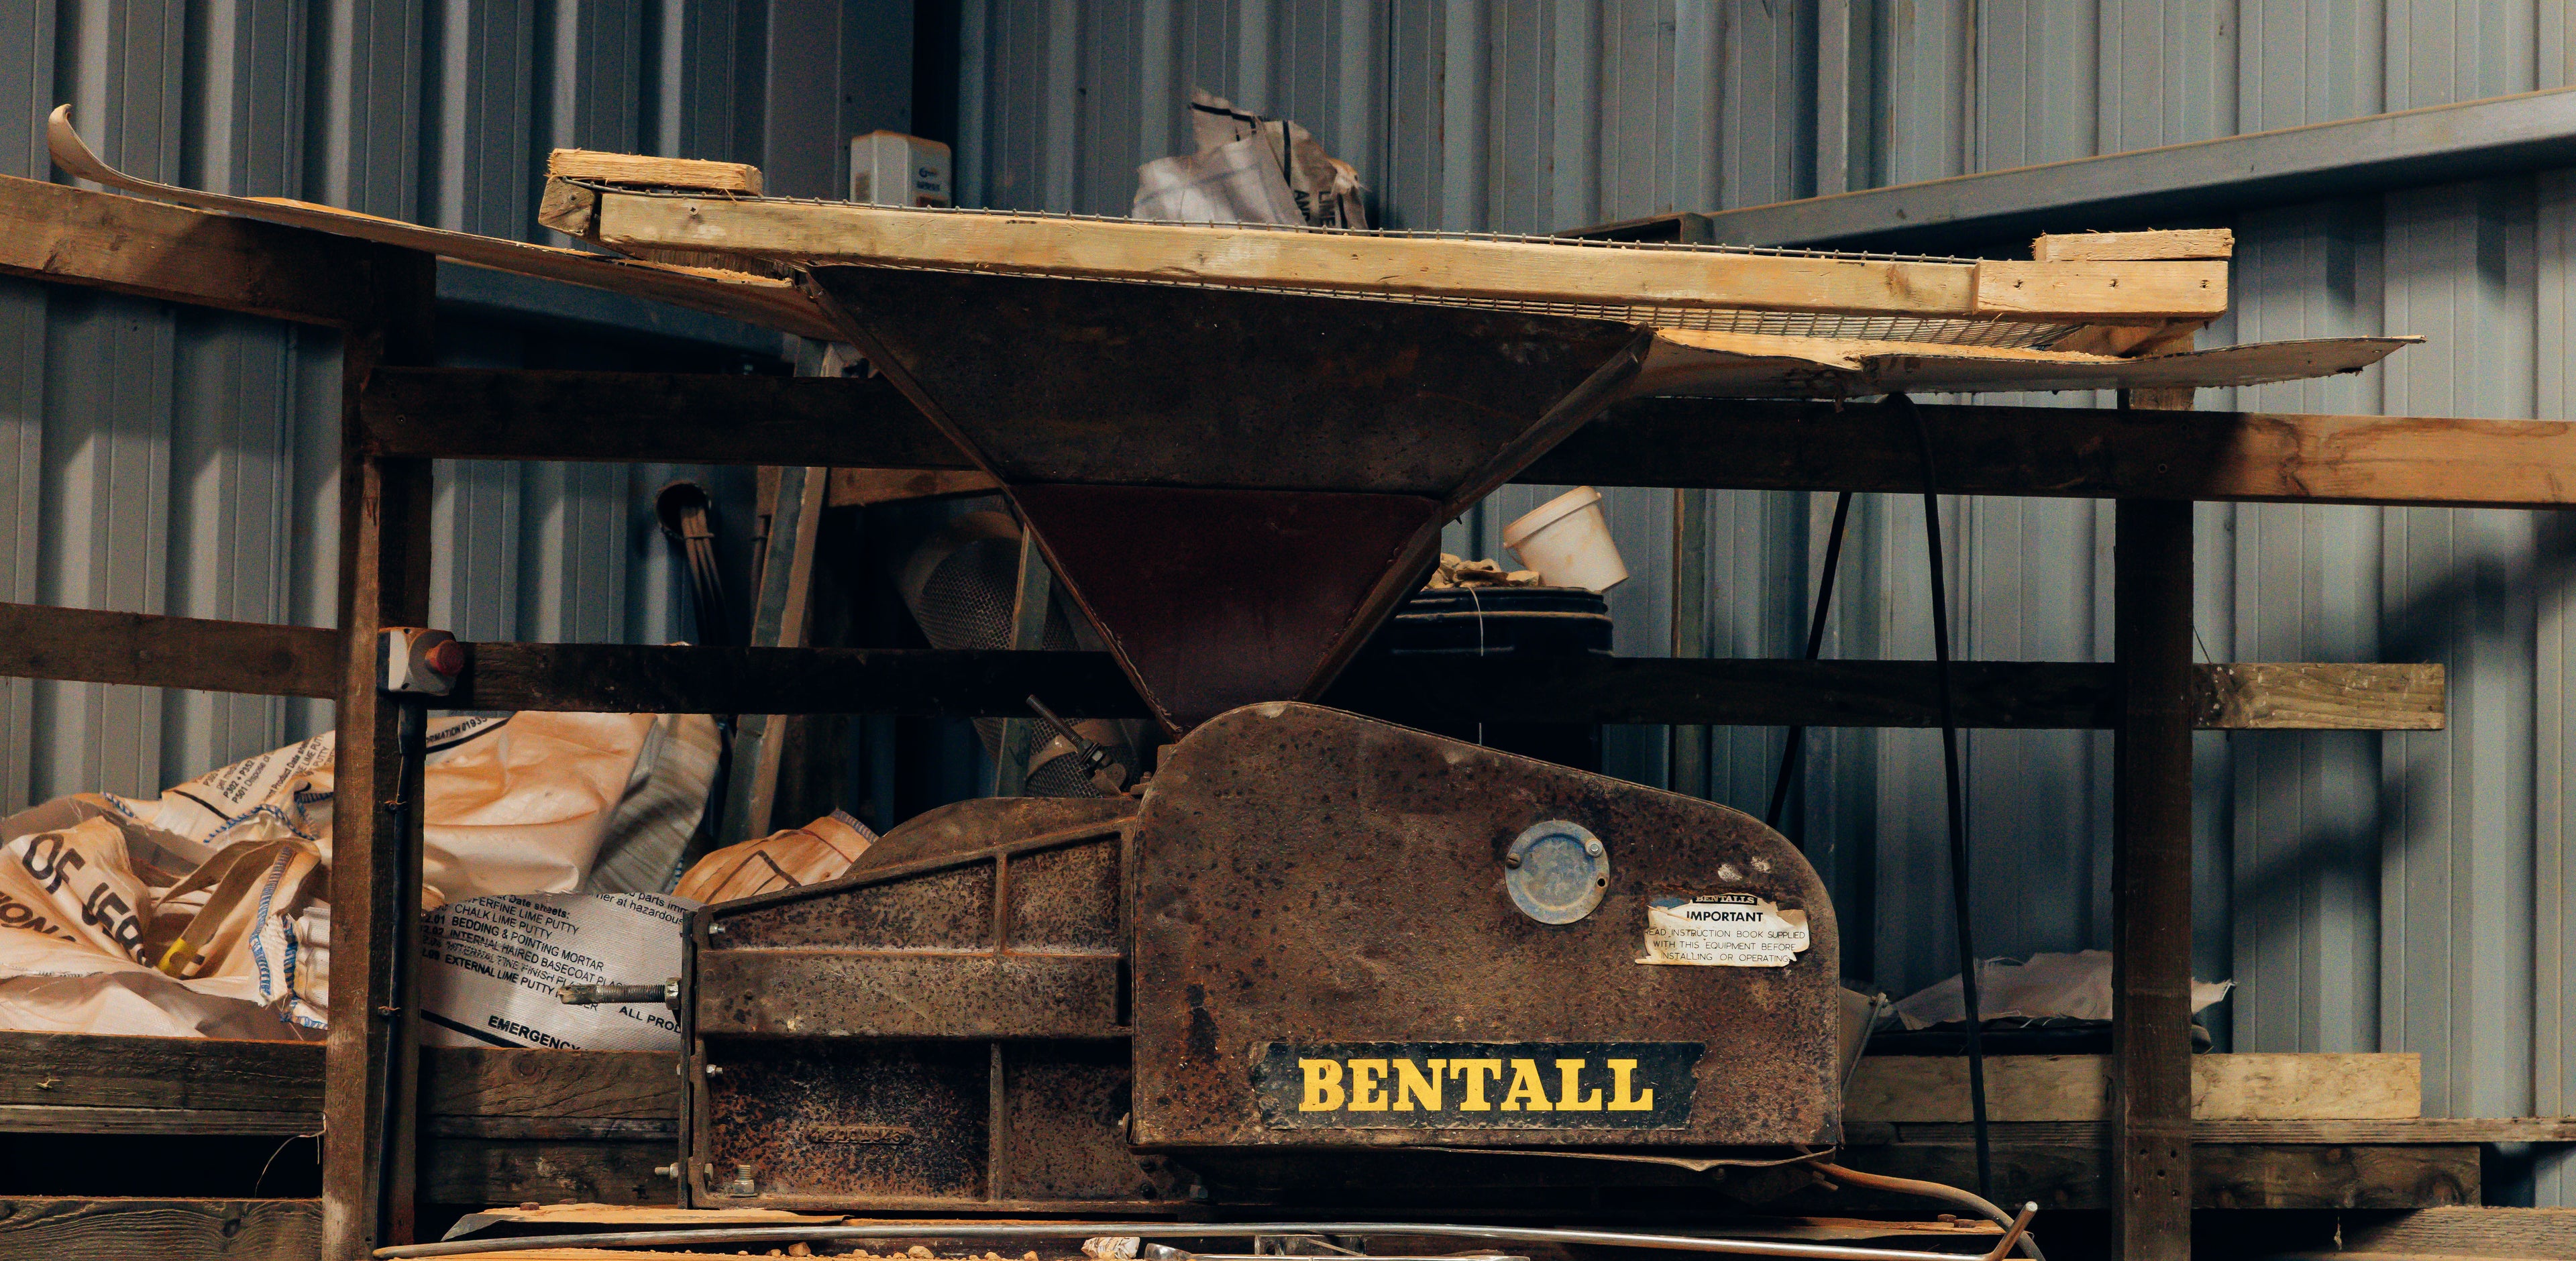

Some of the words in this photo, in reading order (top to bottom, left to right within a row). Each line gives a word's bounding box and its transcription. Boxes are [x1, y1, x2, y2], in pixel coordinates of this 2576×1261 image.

[425, 725, 462, 742] RMATION
[223, 780, 239, 799] P302
[231, 786, 248, 804] P501
[22, 833, 86, 895] OF
[508, 894, 532, 908] Date
[534, 902, 570, 920] sheets:
[638, 892, 665, 908] parts
[1695, 895, 1755, 903] BENTALLS
[454, 903, 491, 921] CHALK
[492, 913, 517, 928] LIME
[519, 921, 553, 939] PUTTY
[616, 898, 628, 908] at
[629, 900, 683, 925] hazardous
[1686, 911, 1764, 922] IMPORTANT
[519, 908, 543, 924] LIME
[545, 916, 580, 935] PUTTY
[1671, 929, 1731, 938] INSTRUCTION
[1736, 930, 1763, 938] BOOK
[1768, 931, 1805, 939] SUPPLIED
[451, 916, 500, 936] BEDDING
[502, 928, 508, 939] &
[511, 931, 559, 957] POINTING
[561, 949, 604, 972] MORTAR
[1653, 940, 1676, 948] WITH
[1679, 940, 1700, 949] THIS
[1705, 942, 1756, 950] EQUIPMENT
[1761, 943, 1796, 951] BEFORE
[449, 929, 499, 951] INTERNAL
[502, 942, 539, 964] HAIRED
[540, 957, 596, 983] BASECOAT
[1661, 952, 1713, 961] INSTALLING
[1719, 953, 1733, 961] OR
[1739, 954, 1790, 963] OPERATING
[444, 953, 495, 977] EXTERNAL
[496, 969, 519, 984] LIME
[520, 976, 555, 996] PUTTY
[618, 1006, 643, 1021] ALL
[1297, 1058, 1654, 1112] BENTALL
